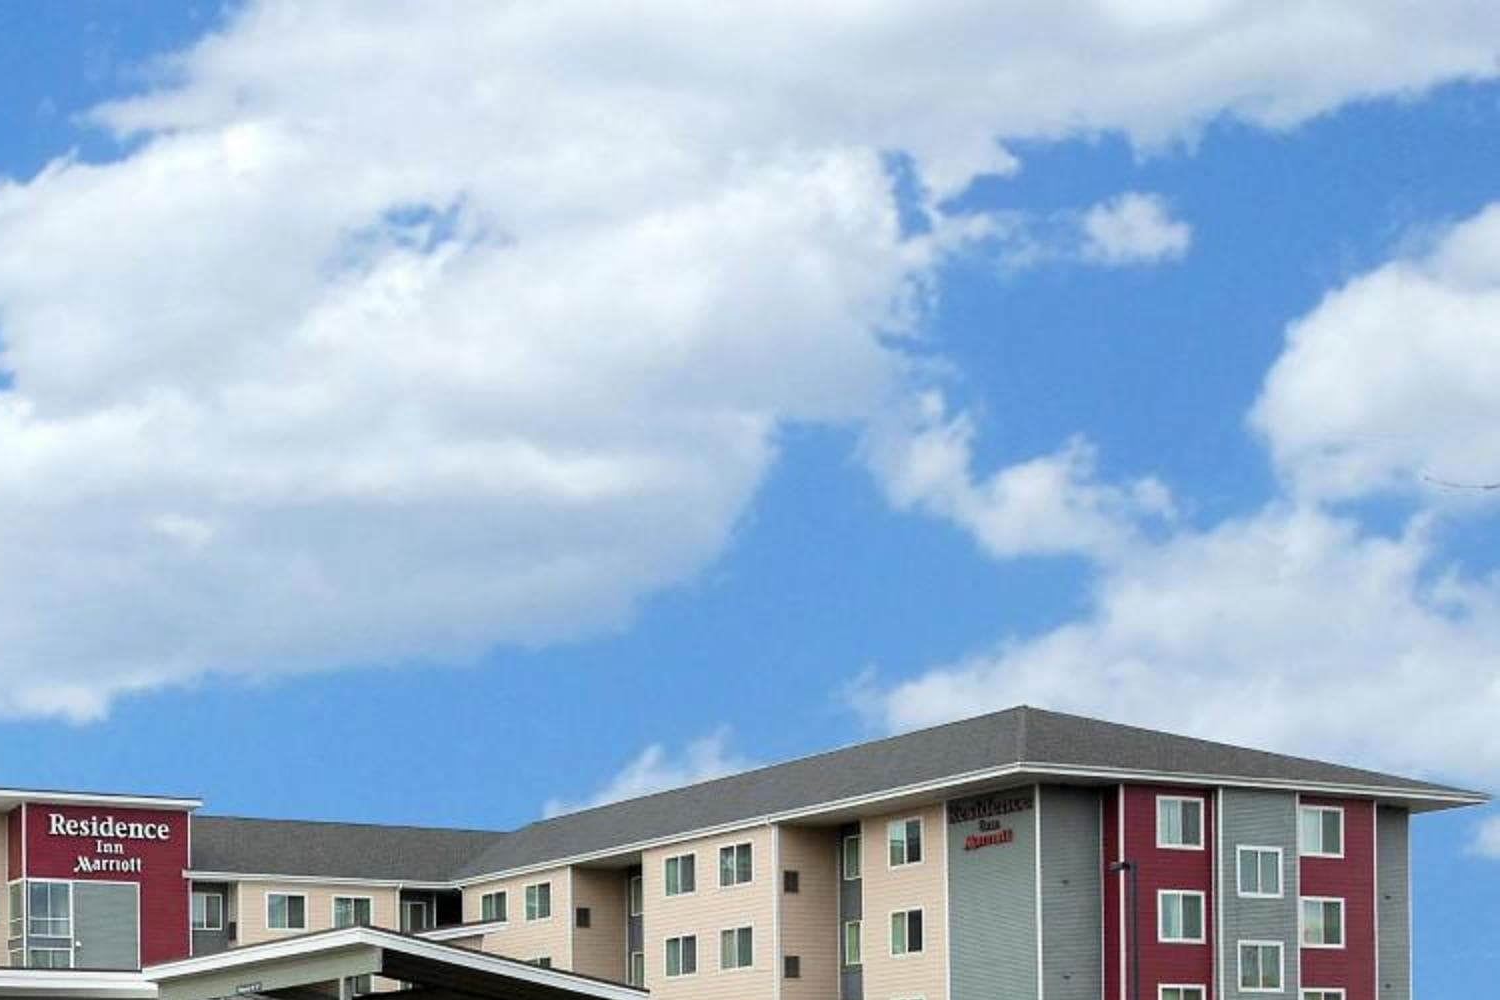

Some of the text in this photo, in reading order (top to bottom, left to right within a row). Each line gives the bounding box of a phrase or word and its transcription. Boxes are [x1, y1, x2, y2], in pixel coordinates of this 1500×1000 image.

[48, 813, 170, 839] Residence
[95, 839, 124, 854] Inn
[73, 855, 141, 873] Marriott
